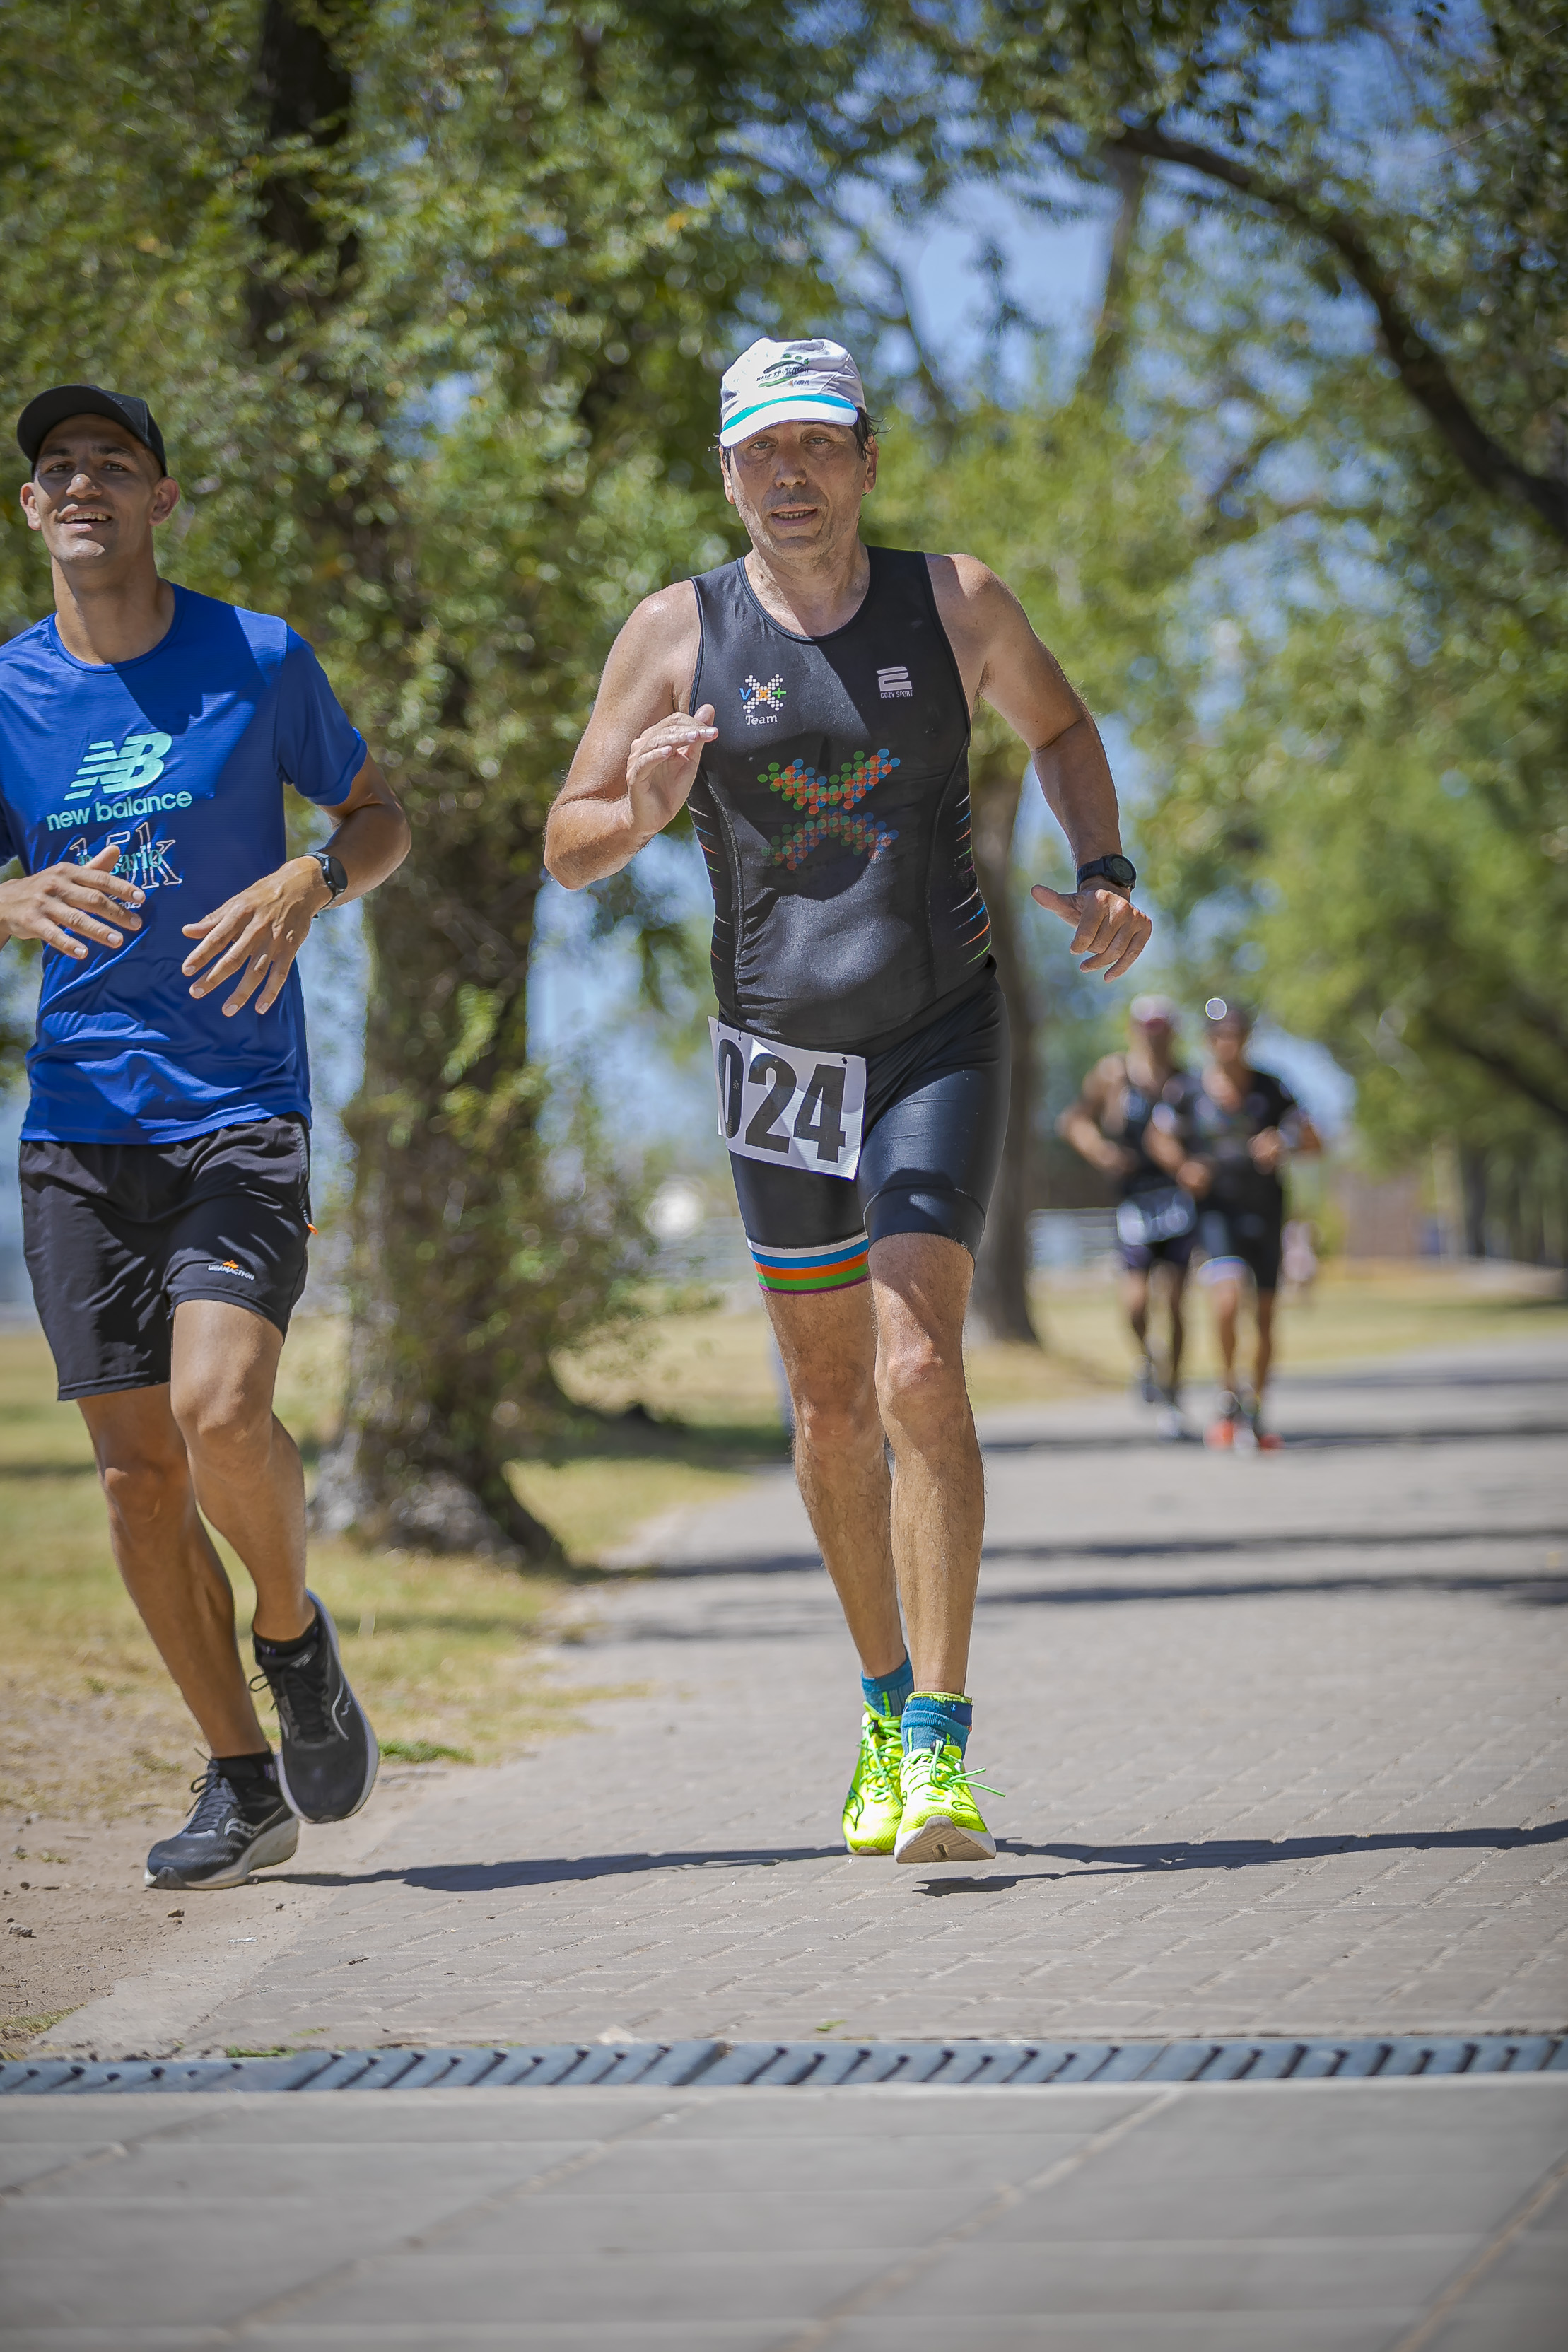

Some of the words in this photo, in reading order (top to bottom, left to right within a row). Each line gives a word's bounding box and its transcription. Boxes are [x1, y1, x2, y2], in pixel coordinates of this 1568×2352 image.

[745, 715, 778, 725] Team
[47, 807, 90, 831] new
[96, 790, 192, 821] balance
[718, 1039, 847, 1163] 024
